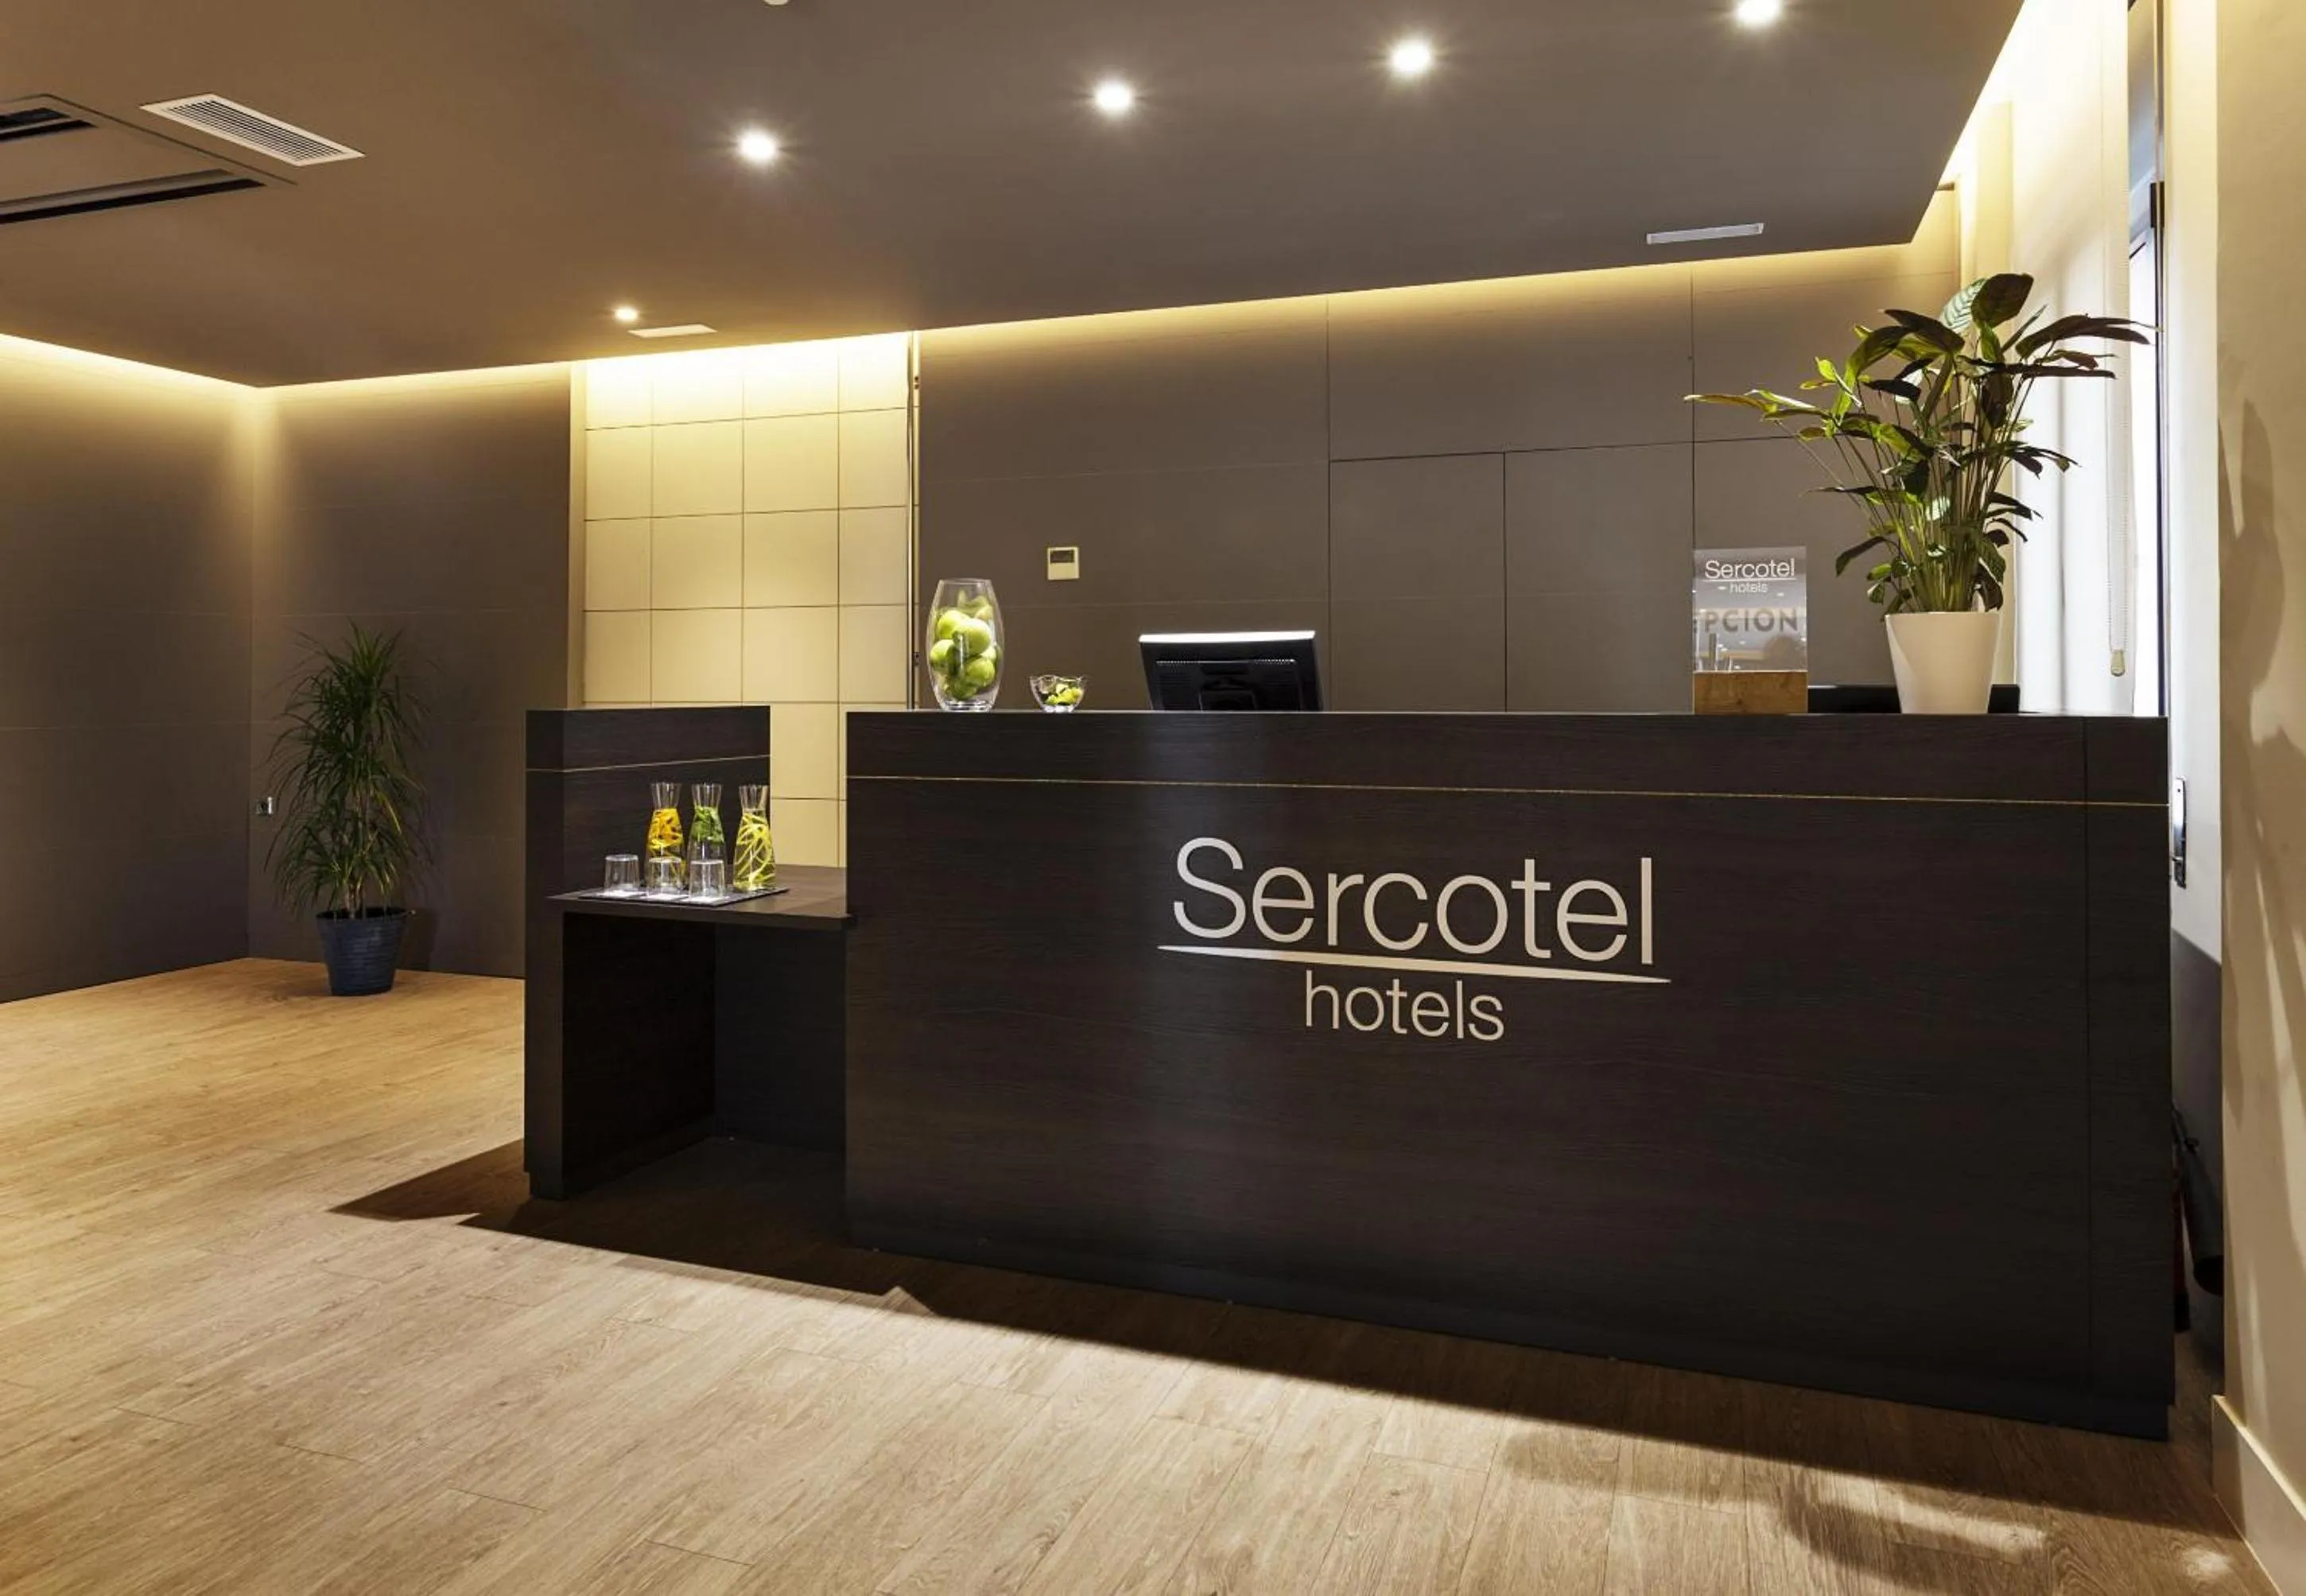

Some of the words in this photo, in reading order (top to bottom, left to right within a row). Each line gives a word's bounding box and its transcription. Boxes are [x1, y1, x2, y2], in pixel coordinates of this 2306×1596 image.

[1704, 557, 1795, 579] Sercotel
[1730, 582, 1768, 593] hotels
[1174, 837, 1653, 965] Sercotel
[1306, 969, 1504, 1041] hotels
